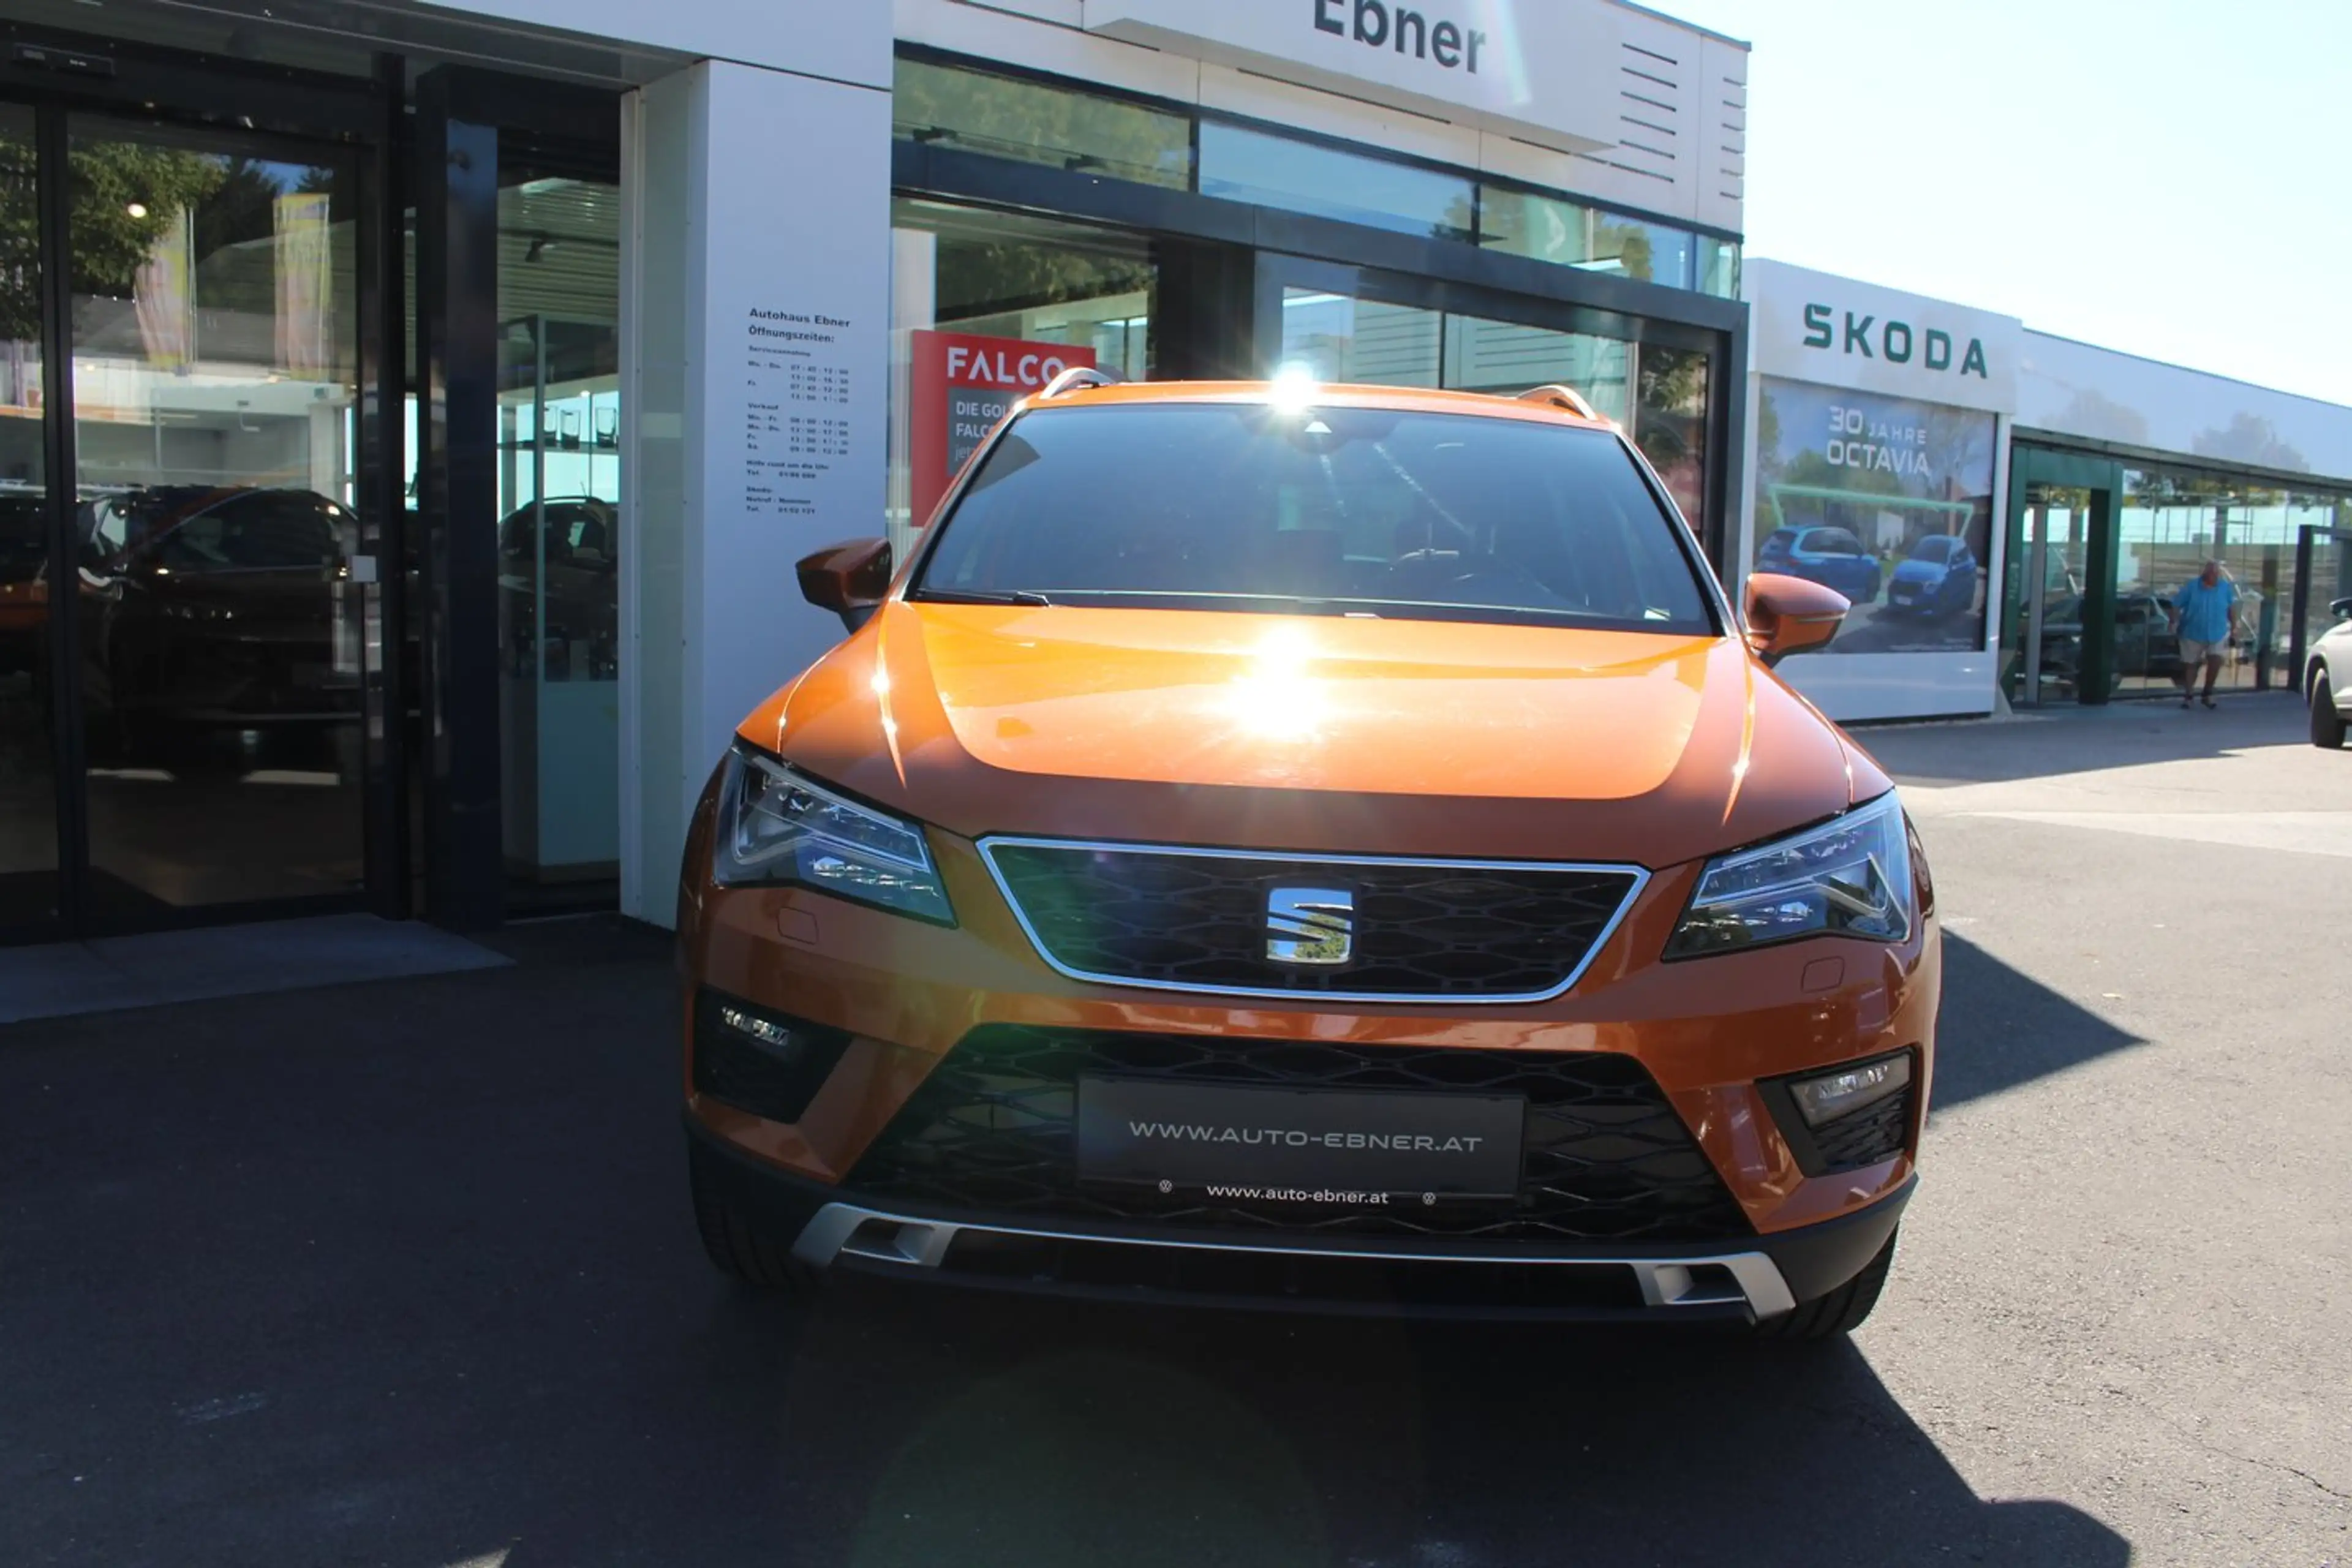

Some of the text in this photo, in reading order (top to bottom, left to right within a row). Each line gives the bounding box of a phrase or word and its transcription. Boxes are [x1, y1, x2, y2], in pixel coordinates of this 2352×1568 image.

[749, 307, 851, 328] Autohaus Ebner
[956, 401, 979, 417] DIE
[1828, 405, 1928, 446] 30 JAHRE
[1827, 439, 1932, 478] OCTAVIA
[1129, 1120, 1483, 1152] WWW.AUTO-EBNER.AT
[1206, 1185, 1389, 1205] www.auto-ebner.at
